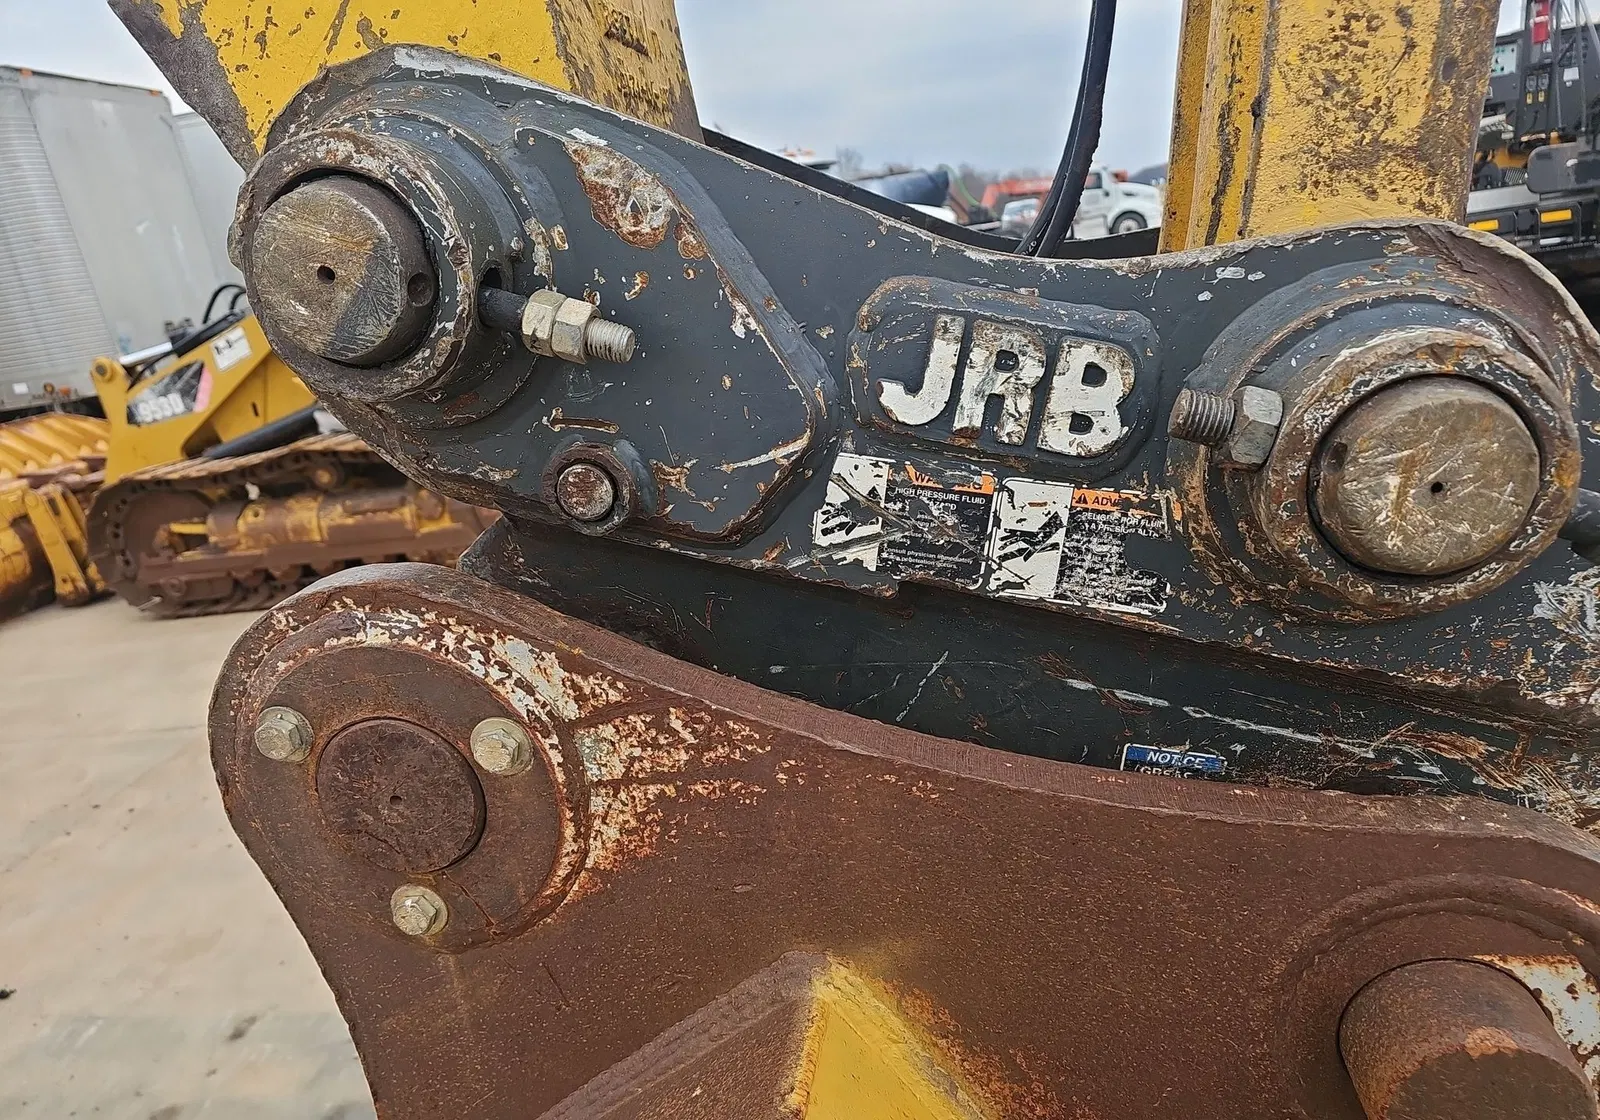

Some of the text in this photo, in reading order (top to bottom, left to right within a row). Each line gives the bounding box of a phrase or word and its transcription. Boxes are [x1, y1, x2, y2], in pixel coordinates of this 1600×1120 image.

[877, 314, 1136, 458] JRB
[895, 486, 986, 505] HIGH PRESSURE FLUID
[884, 546, 907, 555] Consult
[907, 550, 936, 560] physician
[1147, 750, 1206, 769] NOTICE
